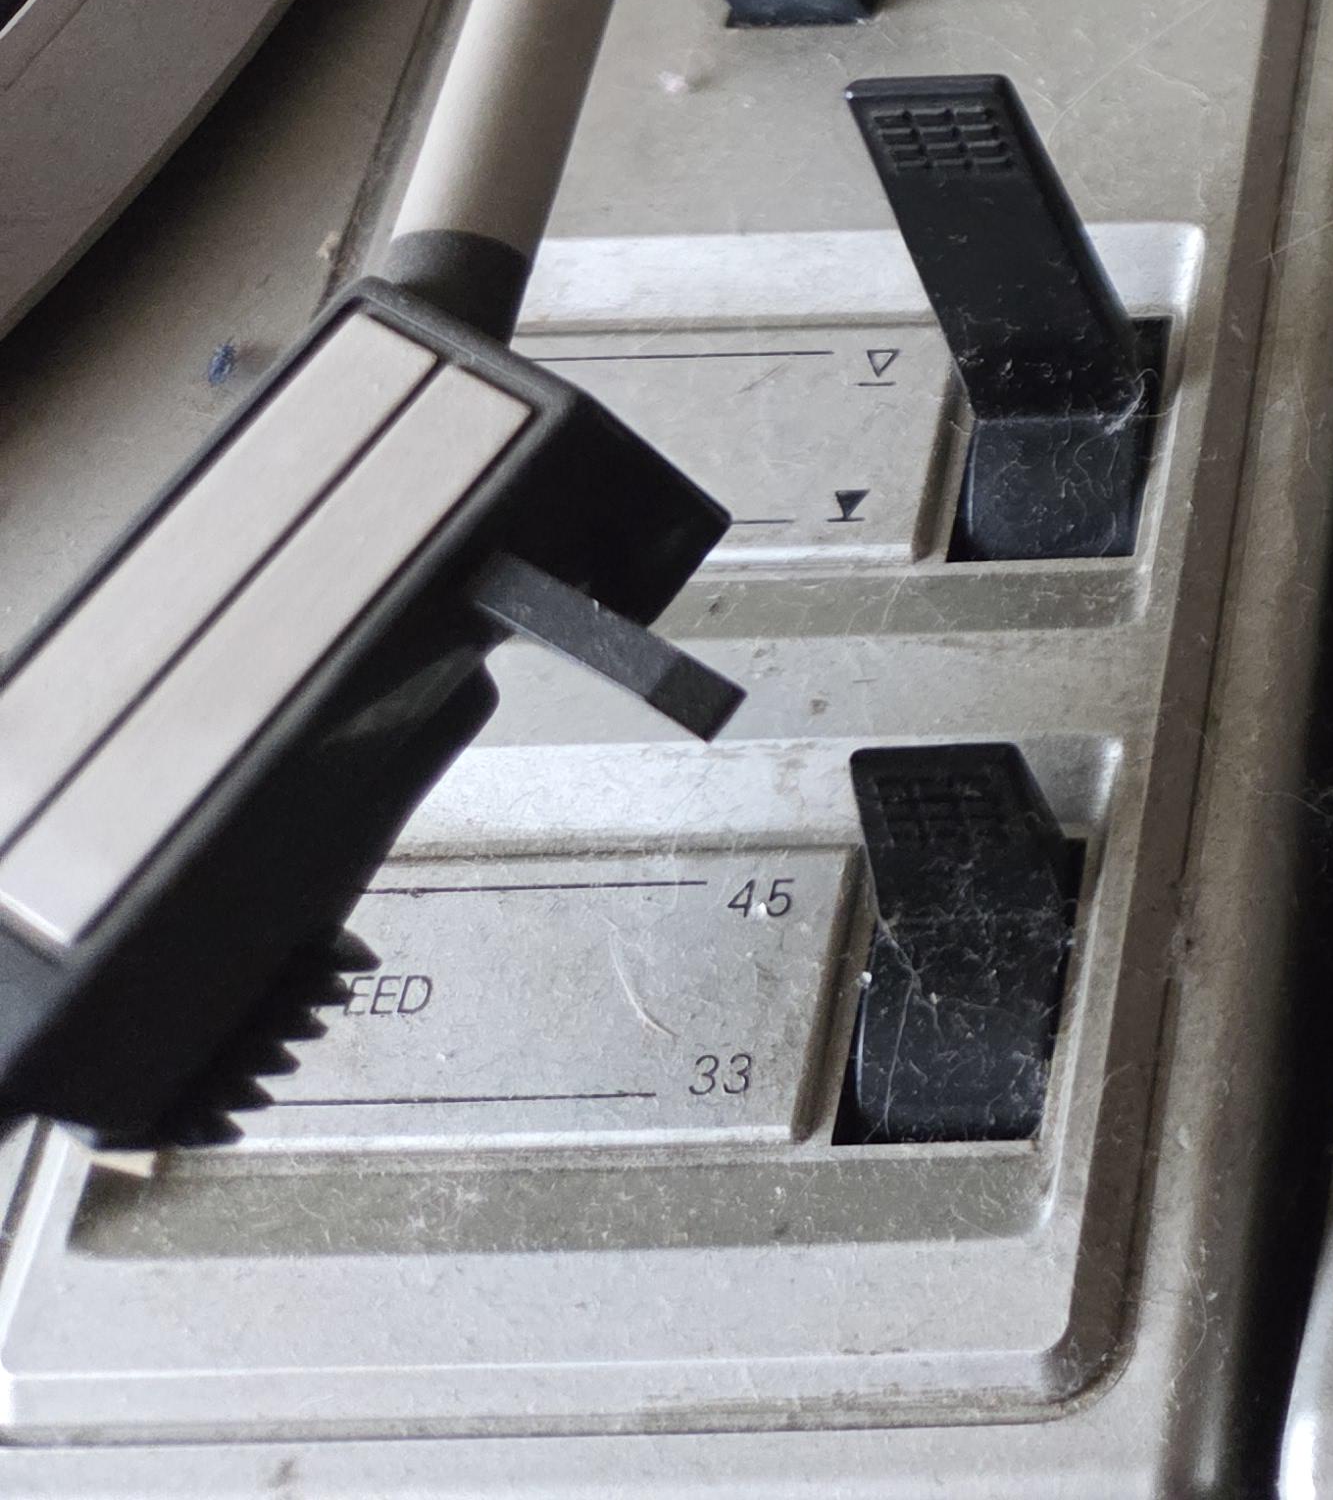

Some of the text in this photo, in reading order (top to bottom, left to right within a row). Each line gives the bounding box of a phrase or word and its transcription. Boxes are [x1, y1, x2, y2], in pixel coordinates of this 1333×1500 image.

[727, 878, 794, 919] 45
[315, 974, 433, 1017] EED
[688, 1054, 754, 1097] 33
